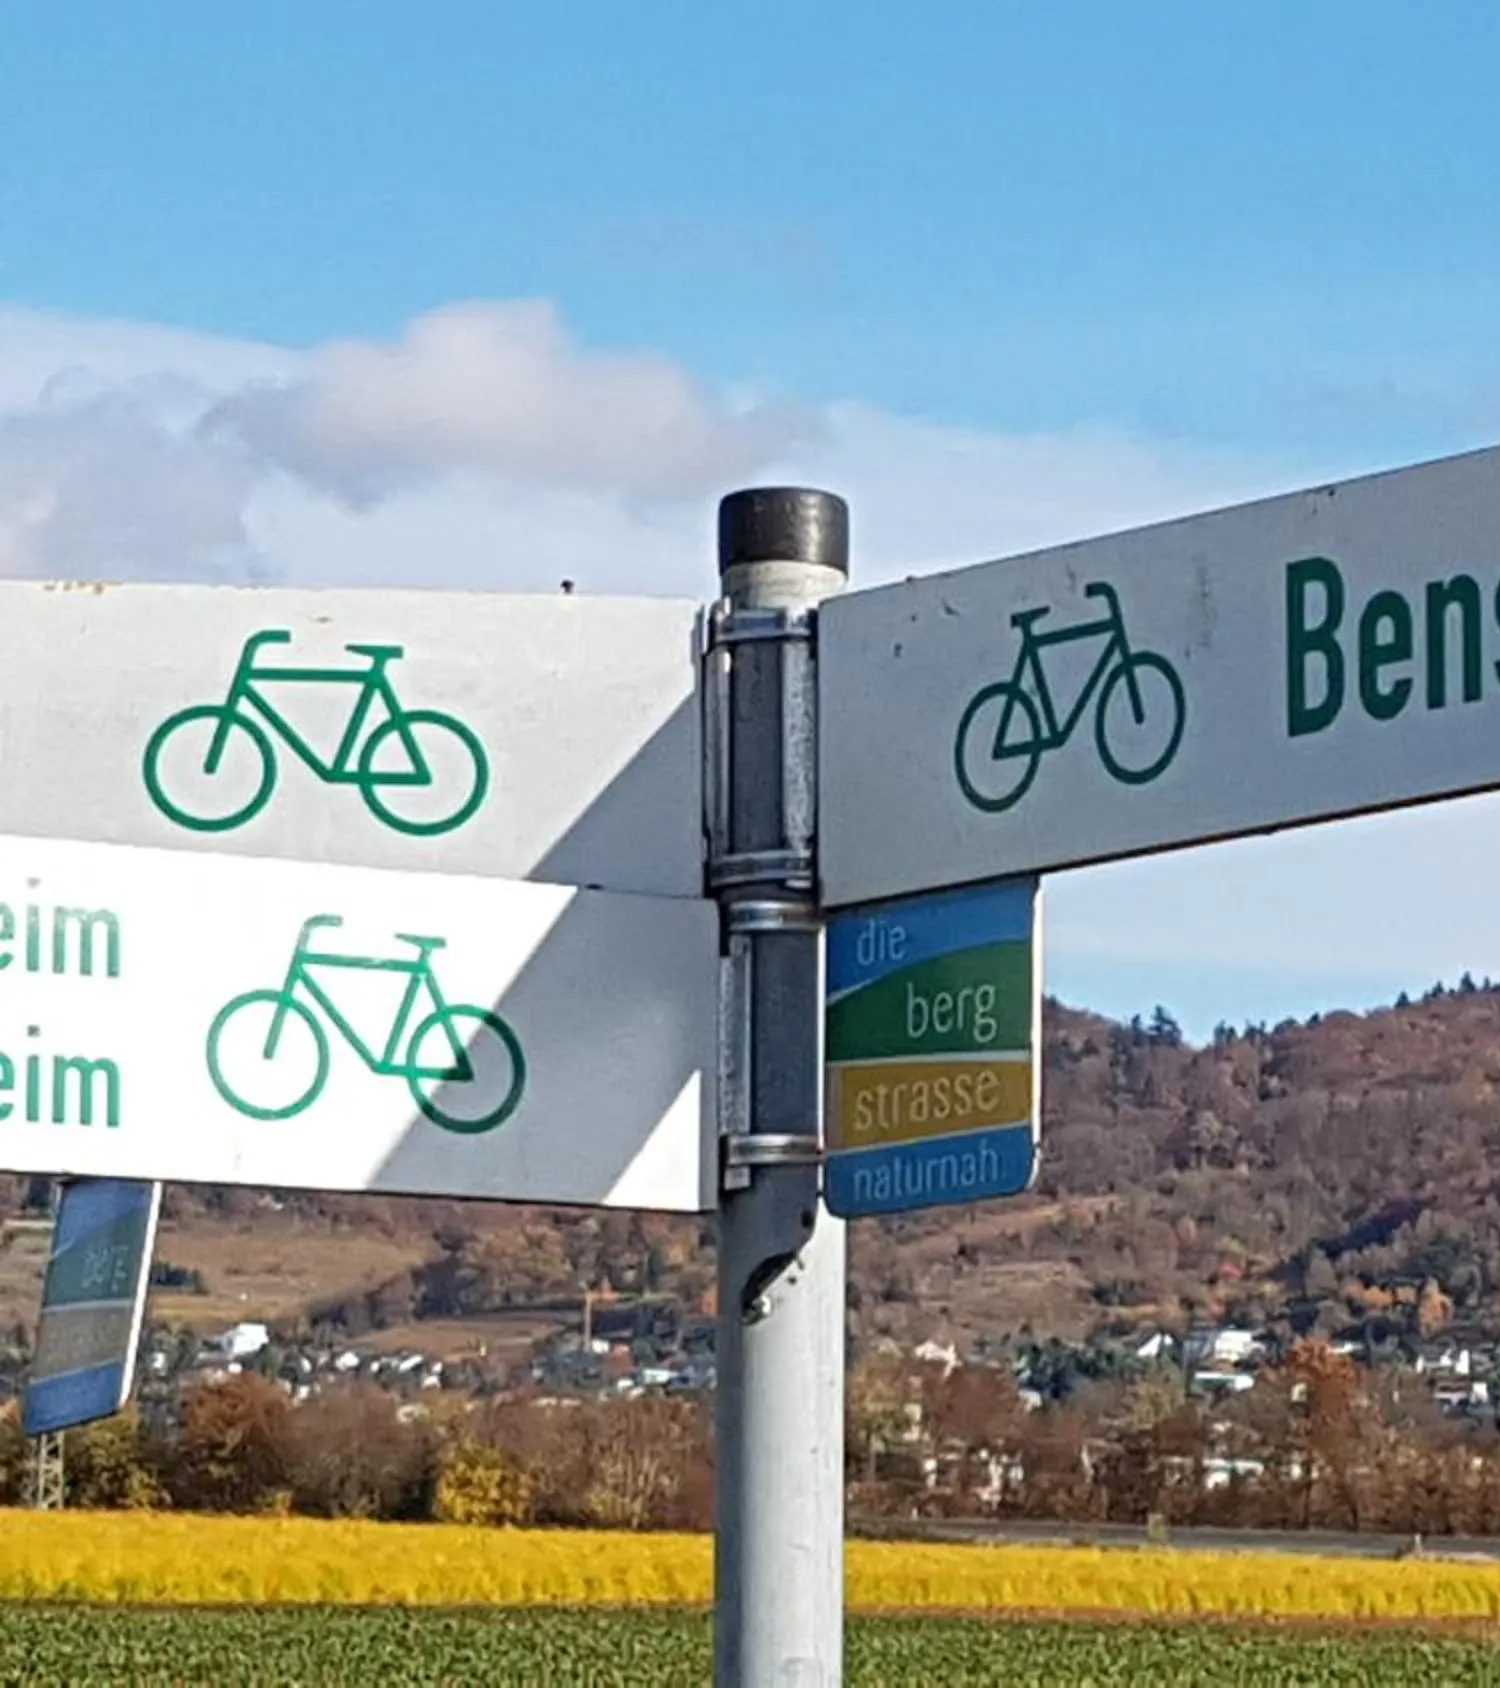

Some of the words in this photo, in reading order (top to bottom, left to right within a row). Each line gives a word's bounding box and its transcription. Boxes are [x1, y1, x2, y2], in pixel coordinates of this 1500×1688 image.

[857, 918, 906, 965] die
[907, 981, 998, 1043] berg
[855, 1069, 1000, 1131] strasse
[853, 1138, 998, 1201] naturnah
